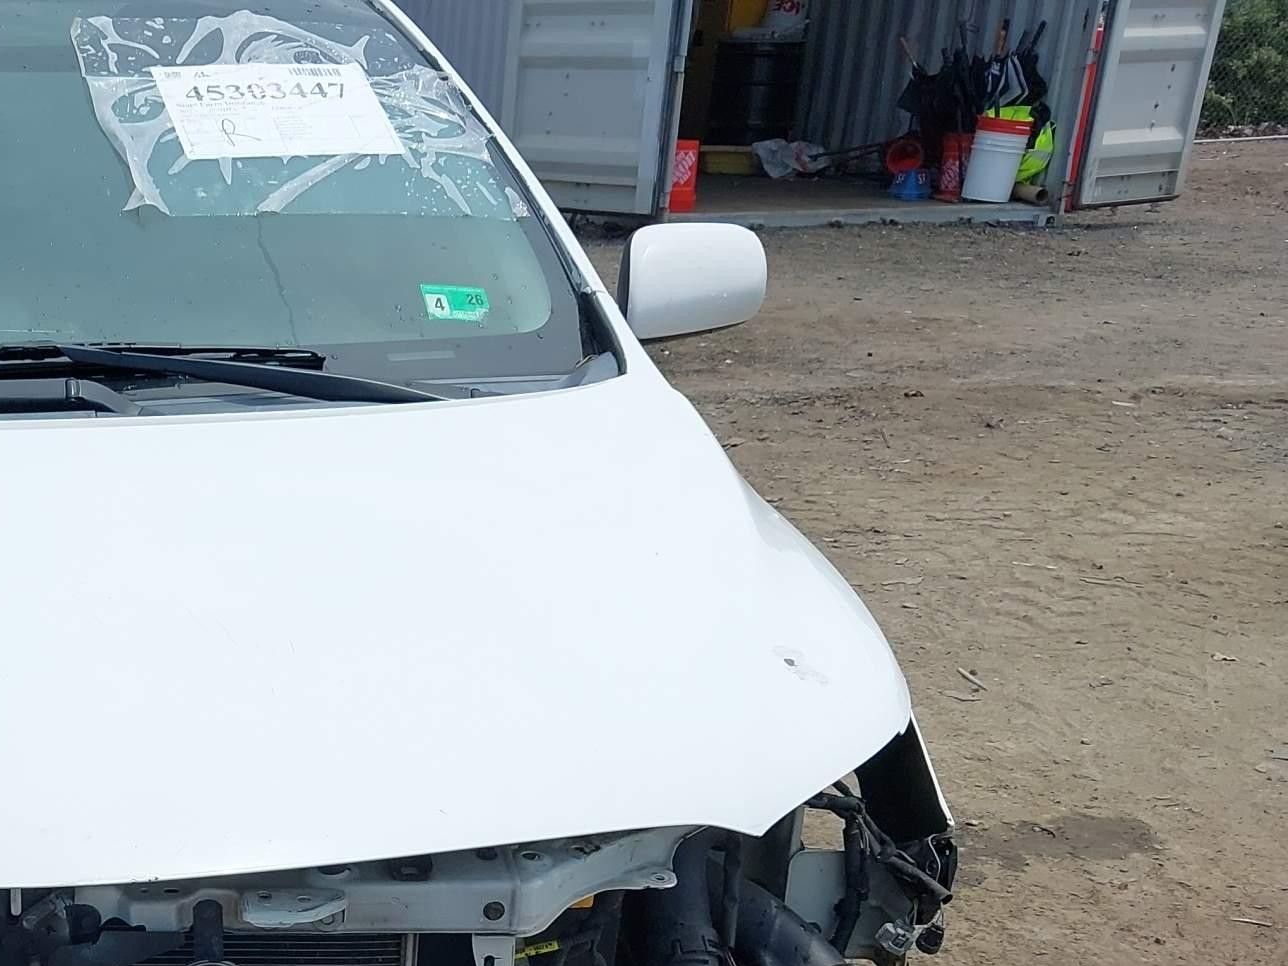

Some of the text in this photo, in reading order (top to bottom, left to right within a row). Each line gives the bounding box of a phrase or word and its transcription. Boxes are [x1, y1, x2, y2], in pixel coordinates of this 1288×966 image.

[185, 82, 344, 102] 45303447
[435, 294, 484, 311] 4 26
